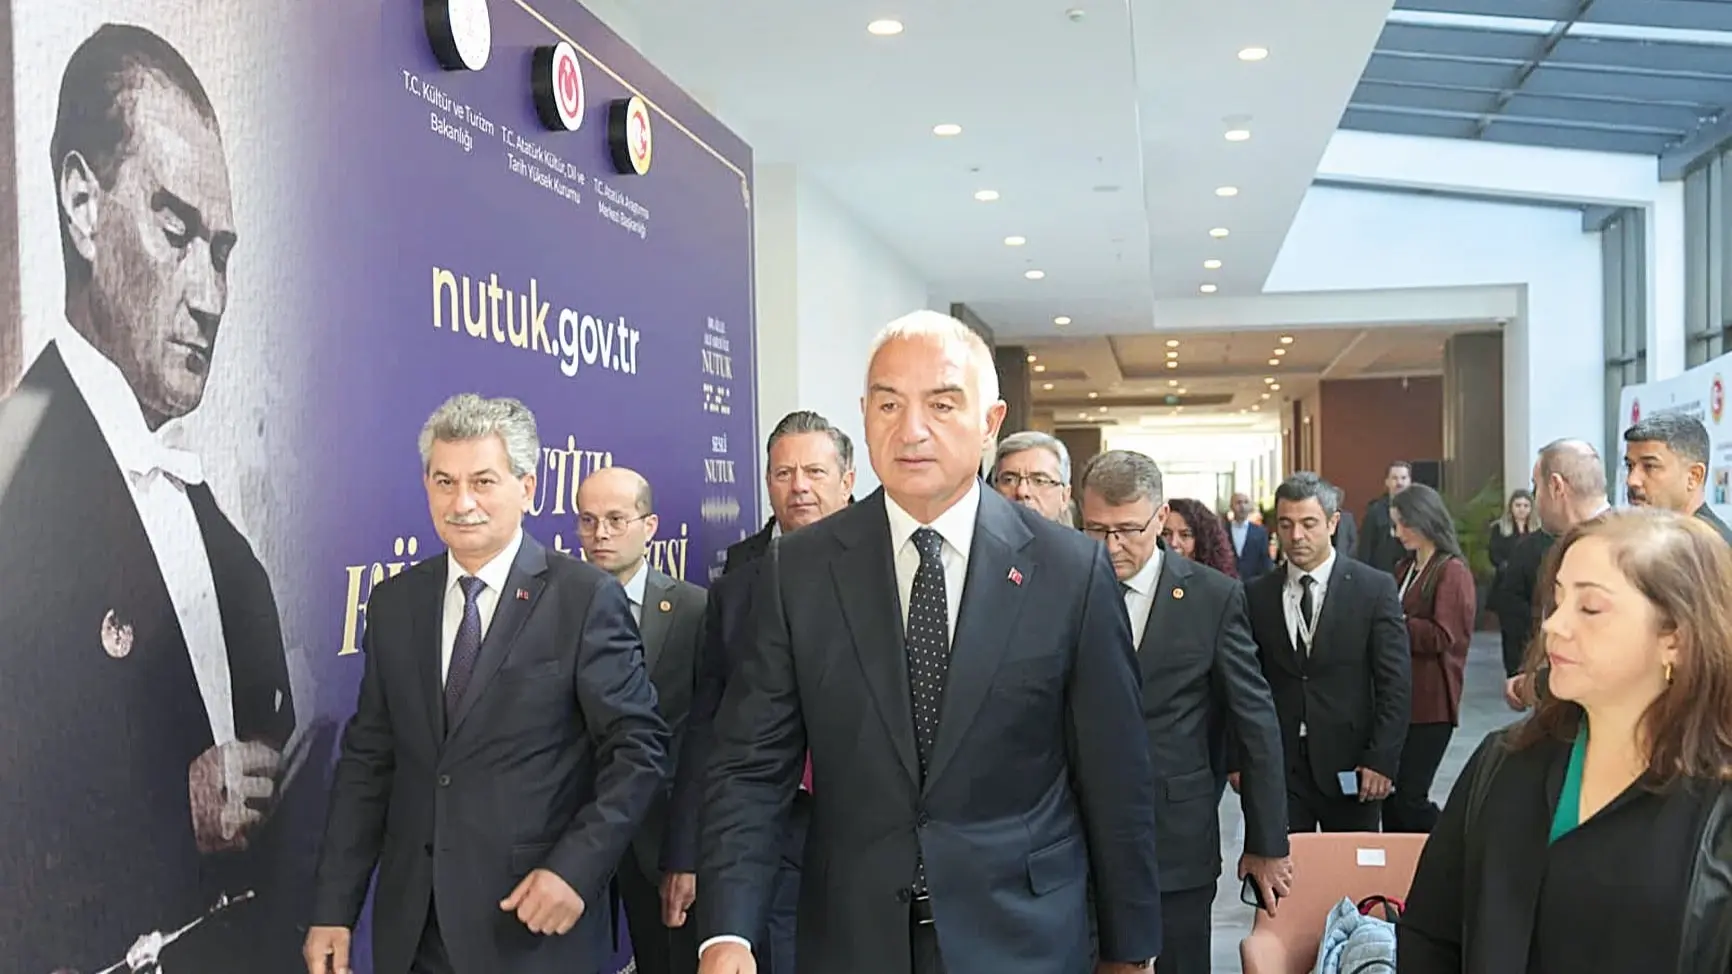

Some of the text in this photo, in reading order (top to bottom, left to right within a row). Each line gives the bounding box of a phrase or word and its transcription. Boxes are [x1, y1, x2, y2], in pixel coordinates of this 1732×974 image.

[402, 69, 495, 137] T.C. Kültür ve Turizm
[431, 112, 473, 153] Bakanlığı
[501, 125, 516, 148] T.C.
[577, 172, 586, 186] ve
[432, 266, 640, 377] nutuk.gov.tr
[702, 348, 733, 380] NUTUK
[703, 458, 735, 484] NUTUK
